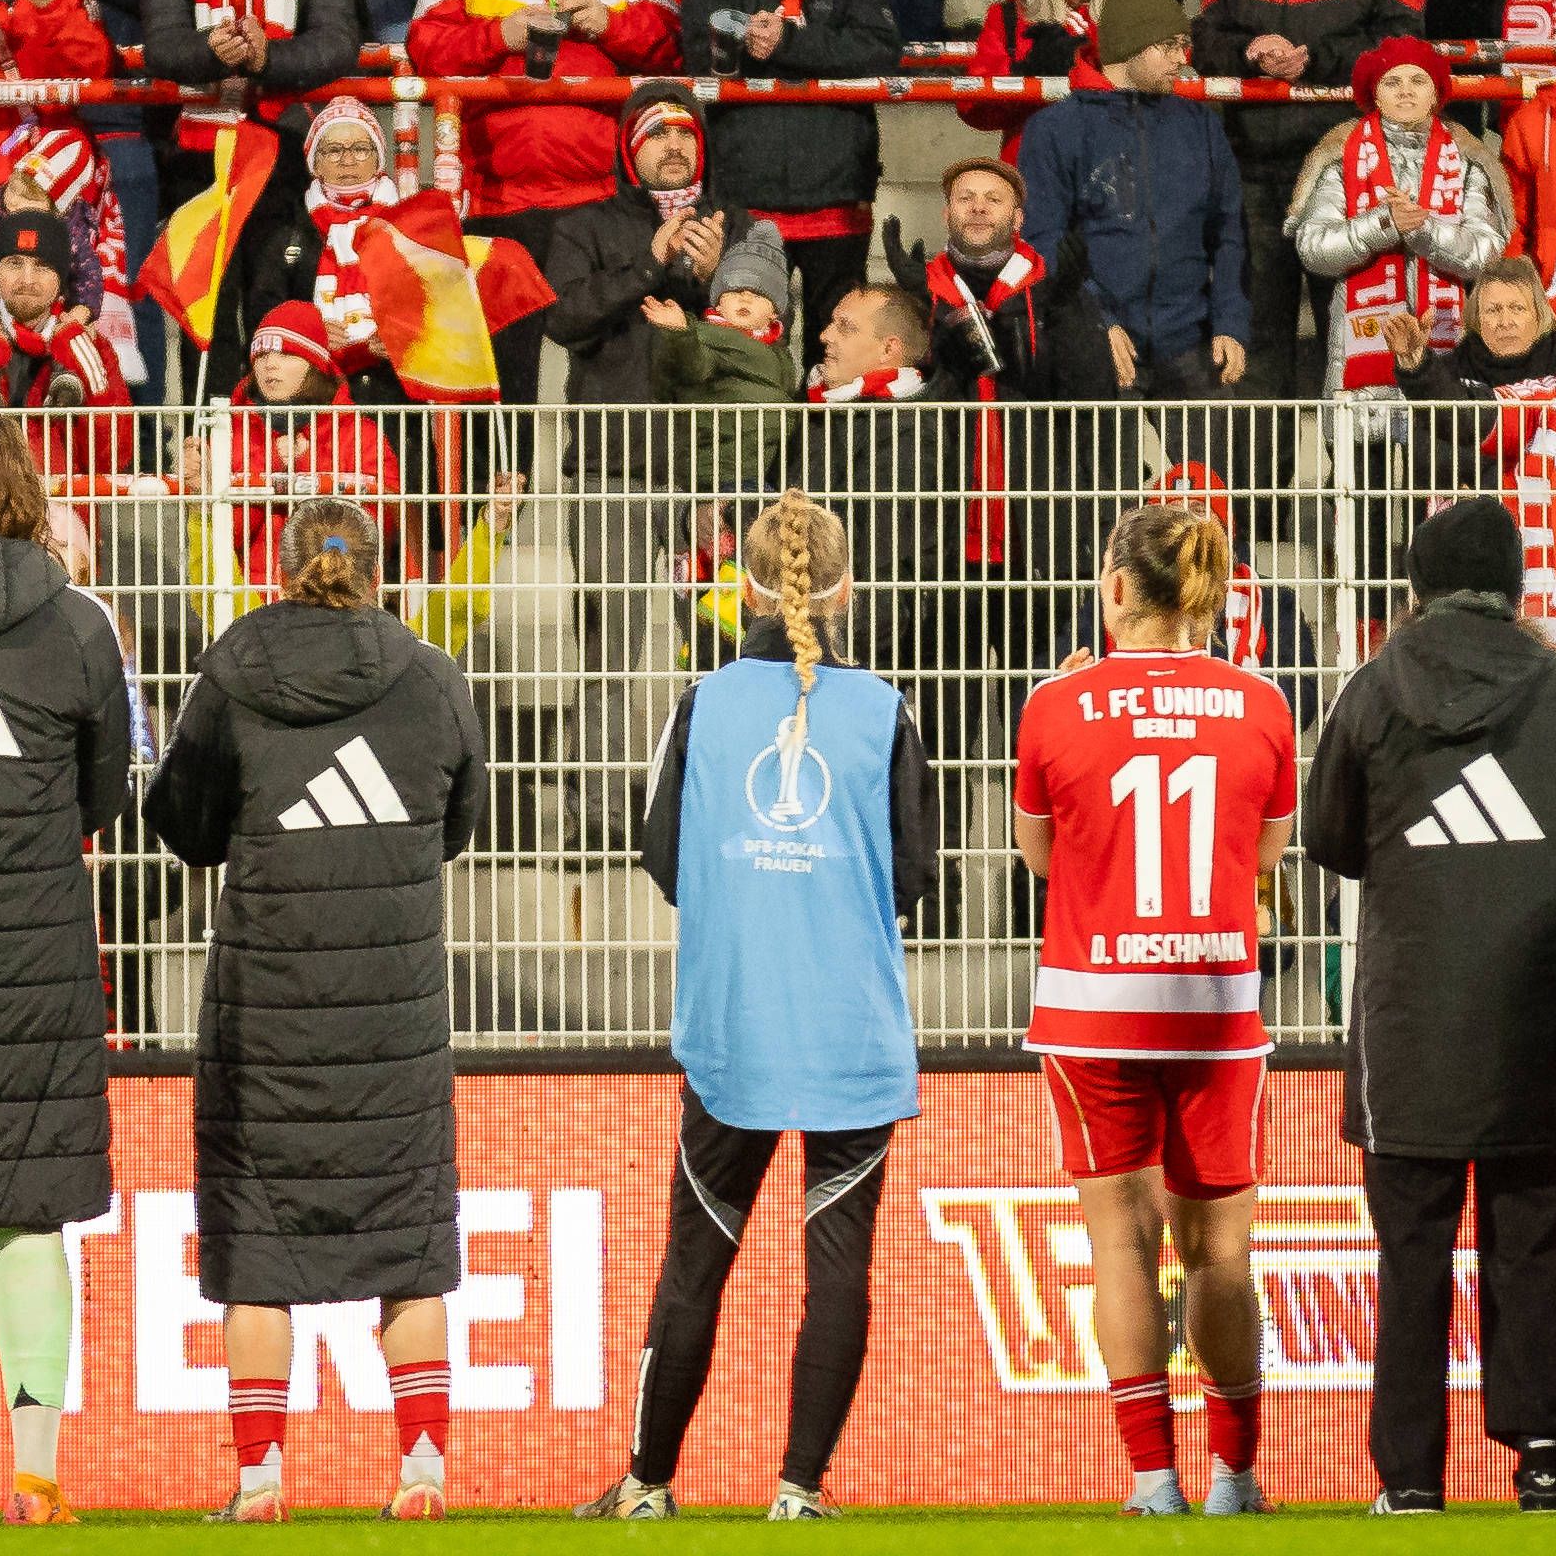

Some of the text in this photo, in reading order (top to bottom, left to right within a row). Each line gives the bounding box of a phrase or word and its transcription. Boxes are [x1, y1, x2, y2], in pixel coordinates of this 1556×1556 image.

[1077, 686, 1245, 721] 1. FC UNION
[1132, 717, 1197, 739] BERLIN
[1110, 754, 1218, 918] 11
[1116, 930, 1248, 964] ORSCHMANN
